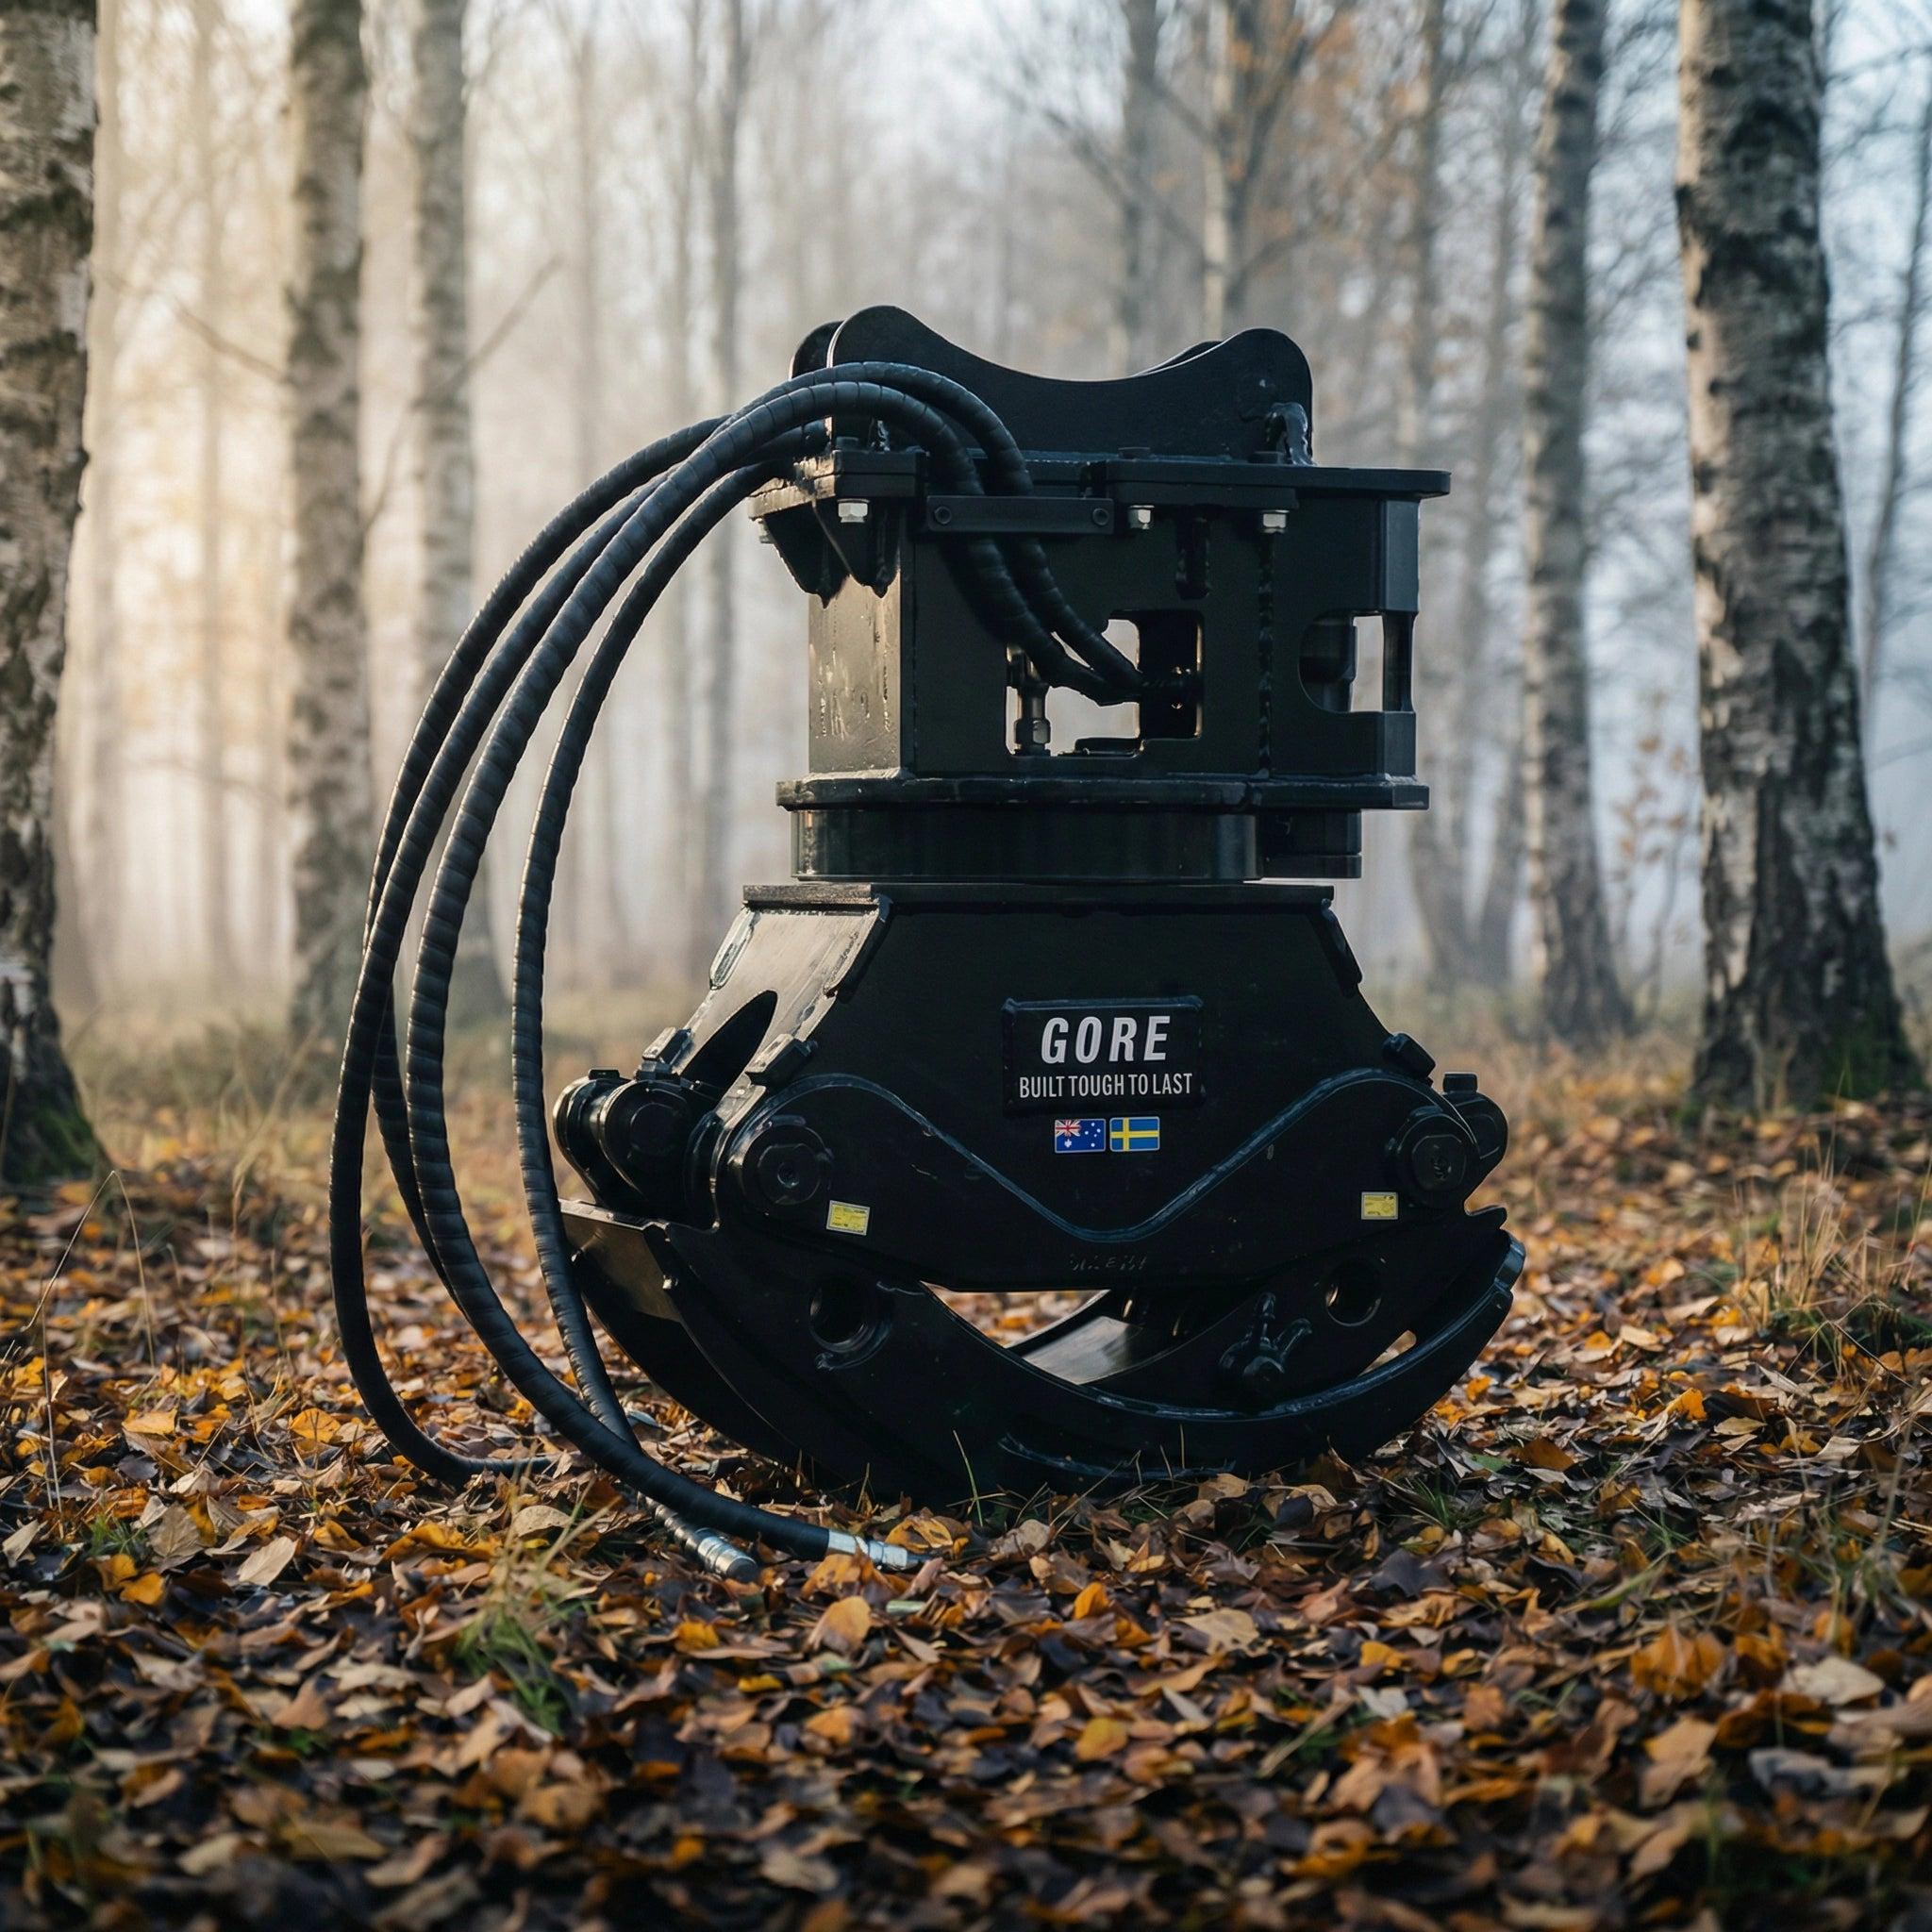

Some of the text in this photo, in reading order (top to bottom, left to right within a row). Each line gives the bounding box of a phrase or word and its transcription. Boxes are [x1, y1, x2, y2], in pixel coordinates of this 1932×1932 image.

[1041, 1015, 1171, 1064] GORE
[1019, 1073, 1192, 1098] BUILT TOUGH TO LAST
